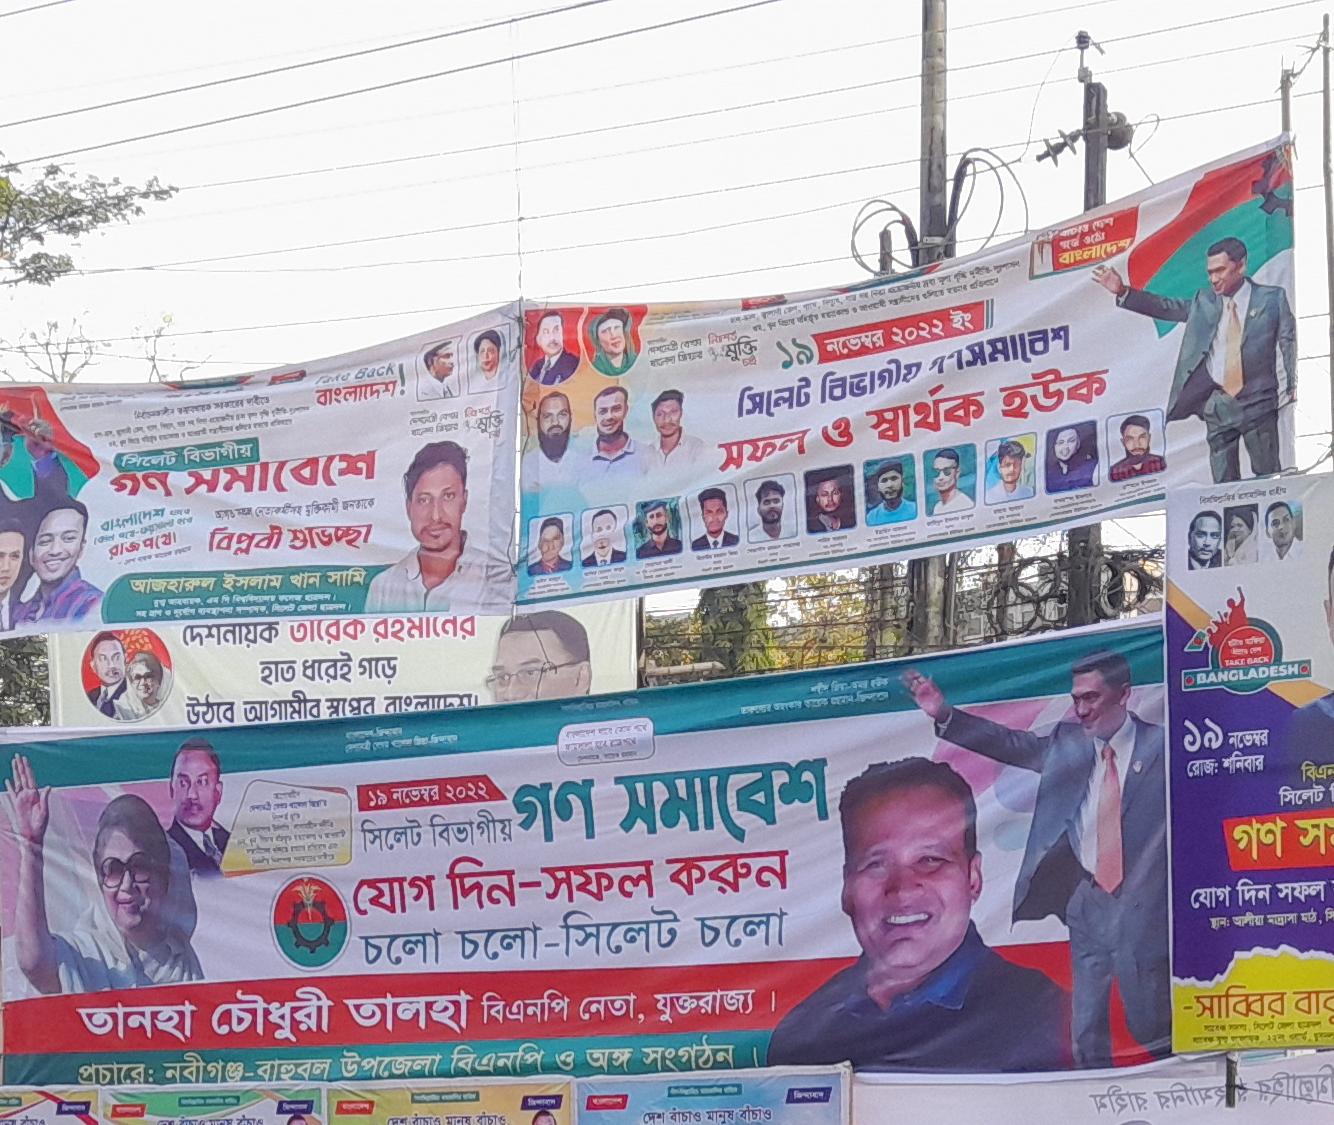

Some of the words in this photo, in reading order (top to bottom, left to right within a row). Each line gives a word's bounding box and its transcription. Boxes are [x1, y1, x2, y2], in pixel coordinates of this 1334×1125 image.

[1058, 238, 1133, 265] বাংলাদেশ
[893, 322, 944, 345] ২০২২
[950, 310, 972, 332] ইং
[725, 334, 758, 363] মুক্তি
[777, 337, 815, 368] ১৯
[738, 377, 811, 418] সিলেট
[821, 358, 922, 406] বিভাগীয়
[718, 426, 811, 473] সফল
[822, 416, 854, 448] ও
[866, 384, 984, 444] স্বার্থক
[999, 368, 1109, 420] হউক
[121, 452, 177, 468] সিলেট
[183, 441, 253, 465] বিভাগীয়
[109, 470, 173, 497] গণ
[185, 450, 378, 495] সমাবেশে
[101, 508, 166, 532] বাংলাদেশ
[208, 525, 282, 555] বিপ্লবী
[288, 524, 372, 549] শুভেচ্ছা
[129, 576, 216, 594] আজহারুল
[223, 572, 282, 590] ইসলাম
[290, 571, 319, 588] খান
[327, 568, 366, 586] সামি
[182, 620, 279, 647] দেশনায়ক
[289, 618, 366, 644] তারেক
[373, 614, 476, 642] রহমানের
[260, 658, 295, 684] হাত
[301, 651, 353, 682] ধরেই
[358, 654, 398, 681] গড়ে
[1196, 663, 1299, 684] BANGLADESH
[1225, 658, 1245, 667] TAKE
[1183, 718, 1223, 752] ১৯
[1228, 729, 1269, 747] নভেম্বর
[361, 820, 424, 852] সিলেট
[430, 810, 513, 848] বিভাগীয়
[512, 779, 595, 844] গণ
[614, 758, 827, 843] সমাবেশ
[368, 789, 387, 808] ১৯
[389, 784, 439, 806] নভেম্বর
[445, 781, 488, 801] ২০২২
[1279, 783, 1325, 806] সিলেট
[1233, 816, 1287, 861] গণ
[354, 876, 436, 917] যোগ
[447, 857, 653, 911] দিন-সফল
[665, 850, 789, 897] করুন
[1191, 884, 1231, 909] যোগ
[1237, 878, 1271, 905] দিন
[1277, 880, 1327, 902] সফল
[358, 930, 441, 966] চলো
[454, 910, 682, 962] চলো-সিলেট
[694, 908, 789, 948] চলো
[76, 1003, 196, 1043] তানহা
[211, 987, 333, 1043] চৌধুরী
[344, 991, 472, 1034] তালহা
[480, 989, 570, 1026] বিএনপি
[579, 994, 645, 1023] নেতা,
[655, 989, 756, 1024] যুক্তরাজ্য
[340, 1046, 443, 1080] উপজেলা
[451, 1043, 546, 1075] বিএনপি
[555, 1049, 574, 1068] ও
[585, 1045, 630, 1070] অঙ্গ
[642, 1036, 735, 1070] সংগঠন
